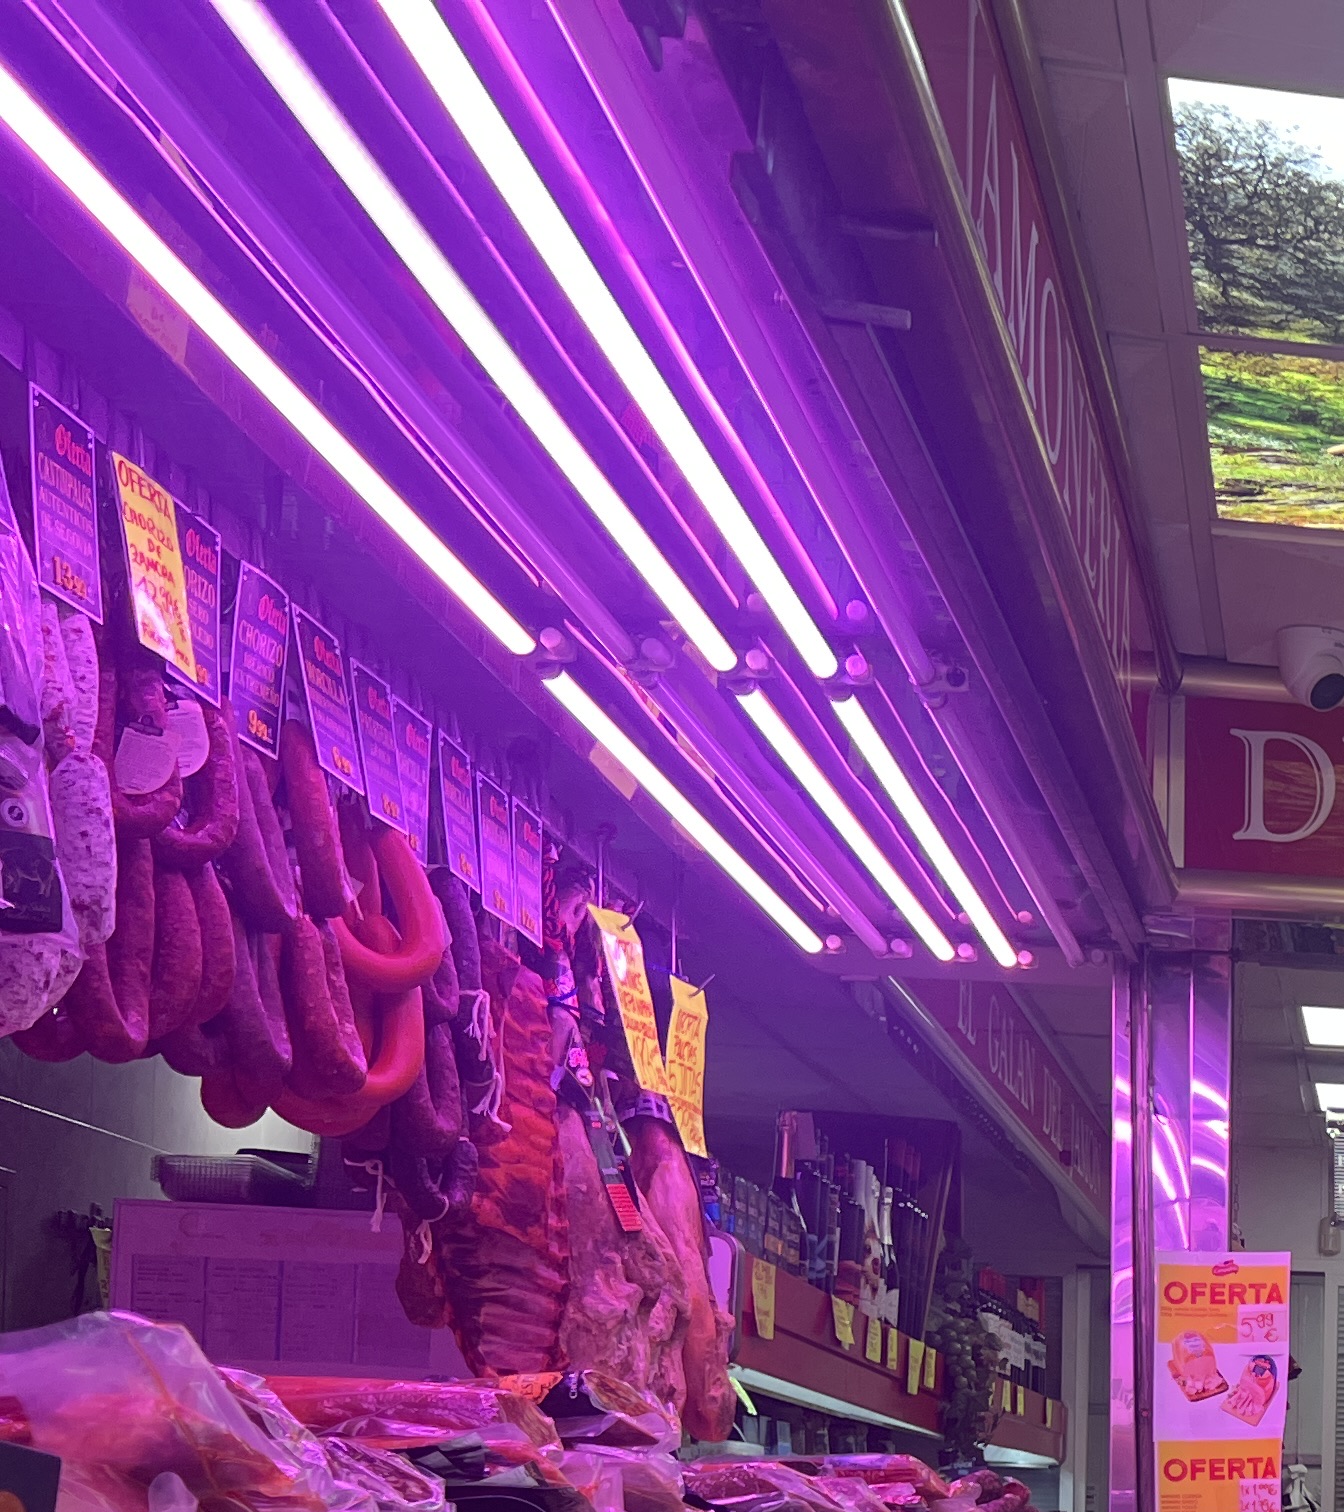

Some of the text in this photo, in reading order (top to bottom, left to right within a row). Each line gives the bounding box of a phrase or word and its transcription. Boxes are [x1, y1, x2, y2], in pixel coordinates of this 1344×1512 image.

[118, 460, 172, 527] OFERTA
[239, 619, 283, 668] CHORIZO
[1164, 1281, 1284, 1305] OFERTA
[1163, 1456, 1277, 1482] OFERTA
